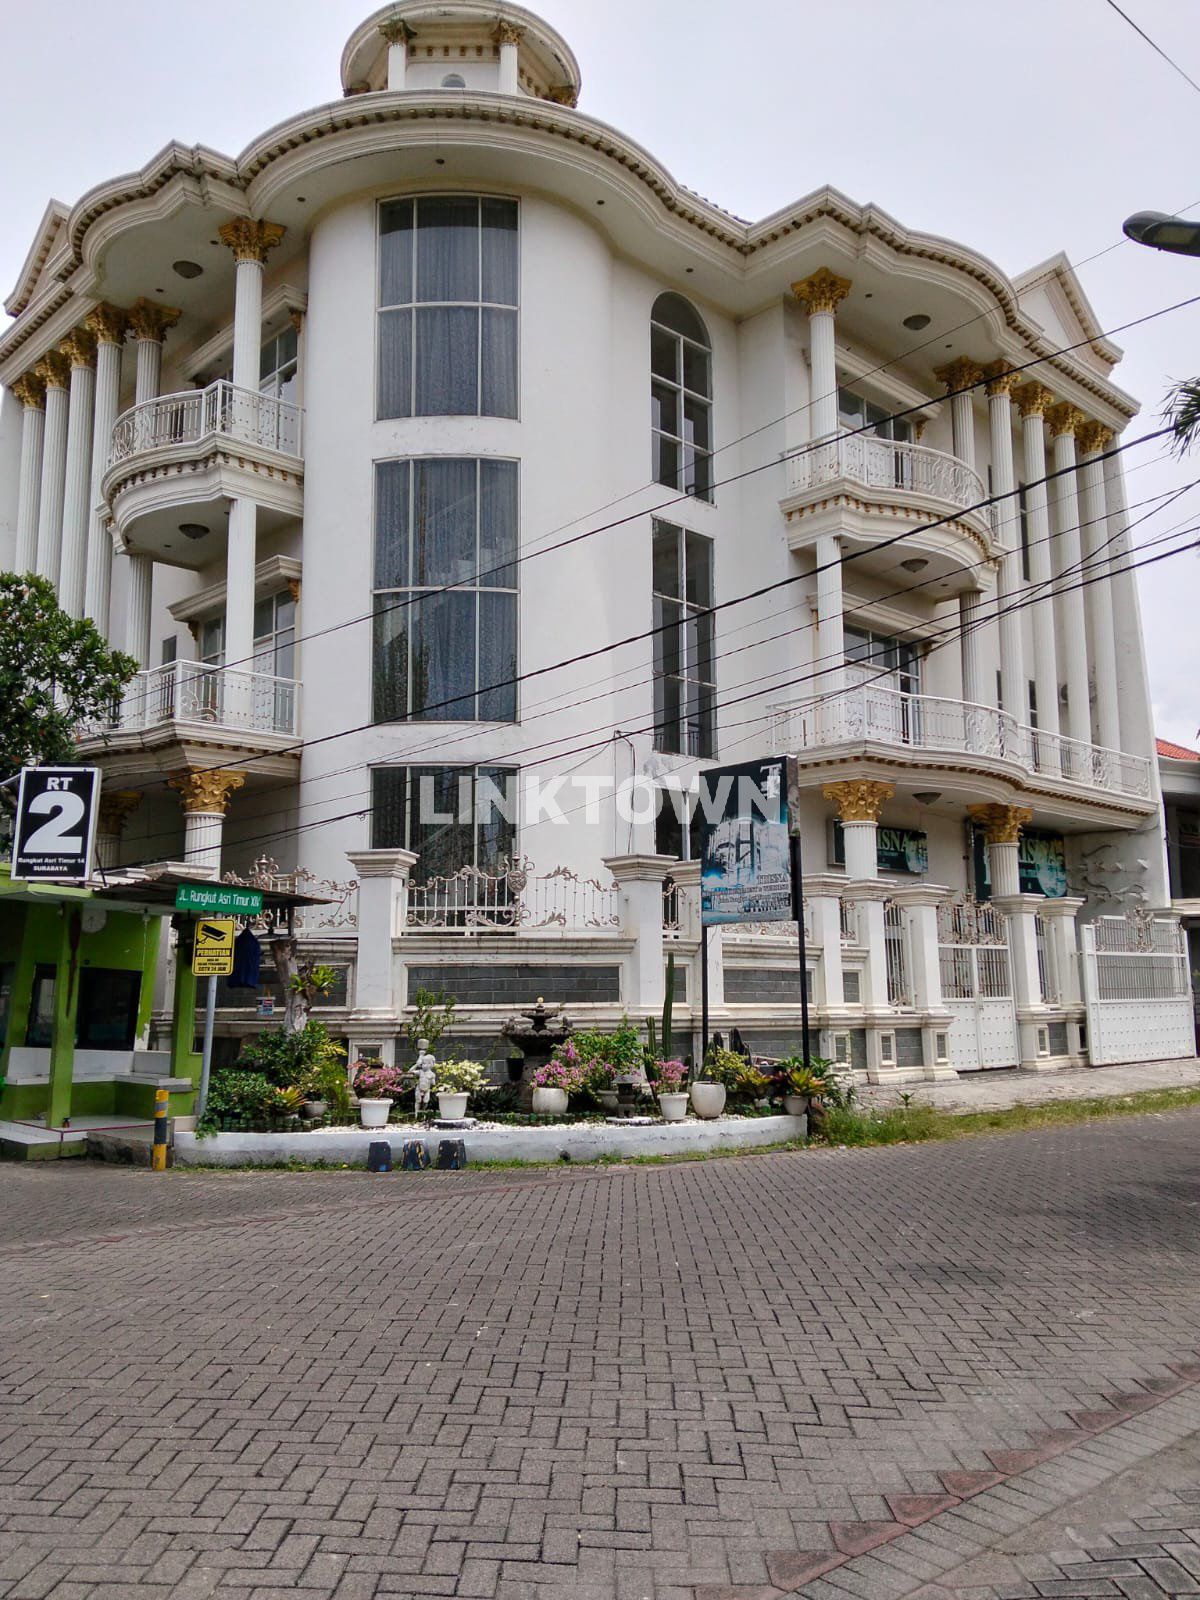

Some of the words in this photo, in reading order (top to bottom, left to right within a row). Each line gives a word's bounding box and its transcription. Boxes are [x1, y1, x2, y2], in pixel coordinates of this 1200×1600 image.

[46, 777, 73, 790] RT
[23, 790, 85, 854] 2
[190, 890, 217, 906] Rungkut
[218, 892, 231, 905] Asri
[232, 893, 249, 907] Timur
[250, 895, 261, 907] XIV
